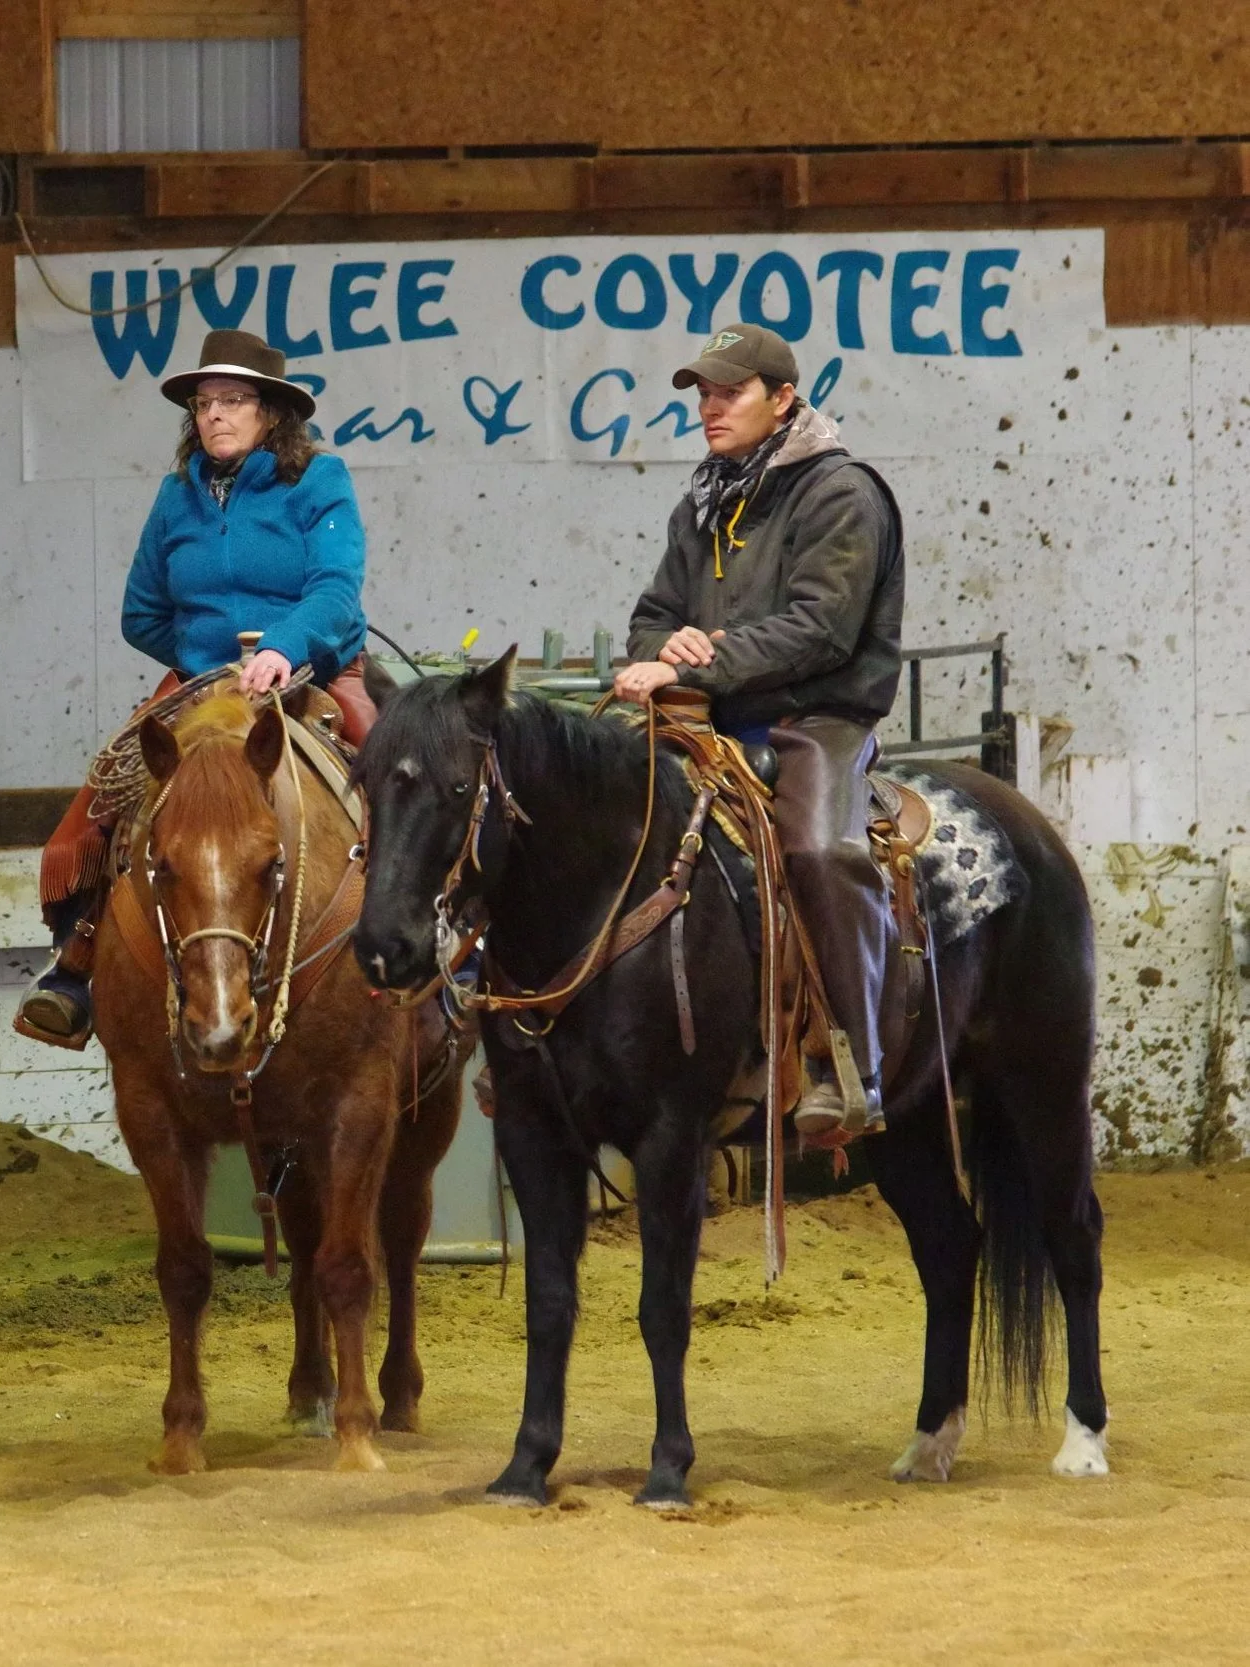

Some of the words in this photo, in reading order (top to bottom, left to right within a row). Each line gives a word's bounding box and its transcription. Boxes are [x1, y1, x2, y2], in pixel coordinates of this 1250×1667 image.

[90, 260, 458, 380] WYLEE
[520, 249, 1023, 357] COYOTEE
[463, 376, 531, 445] &
